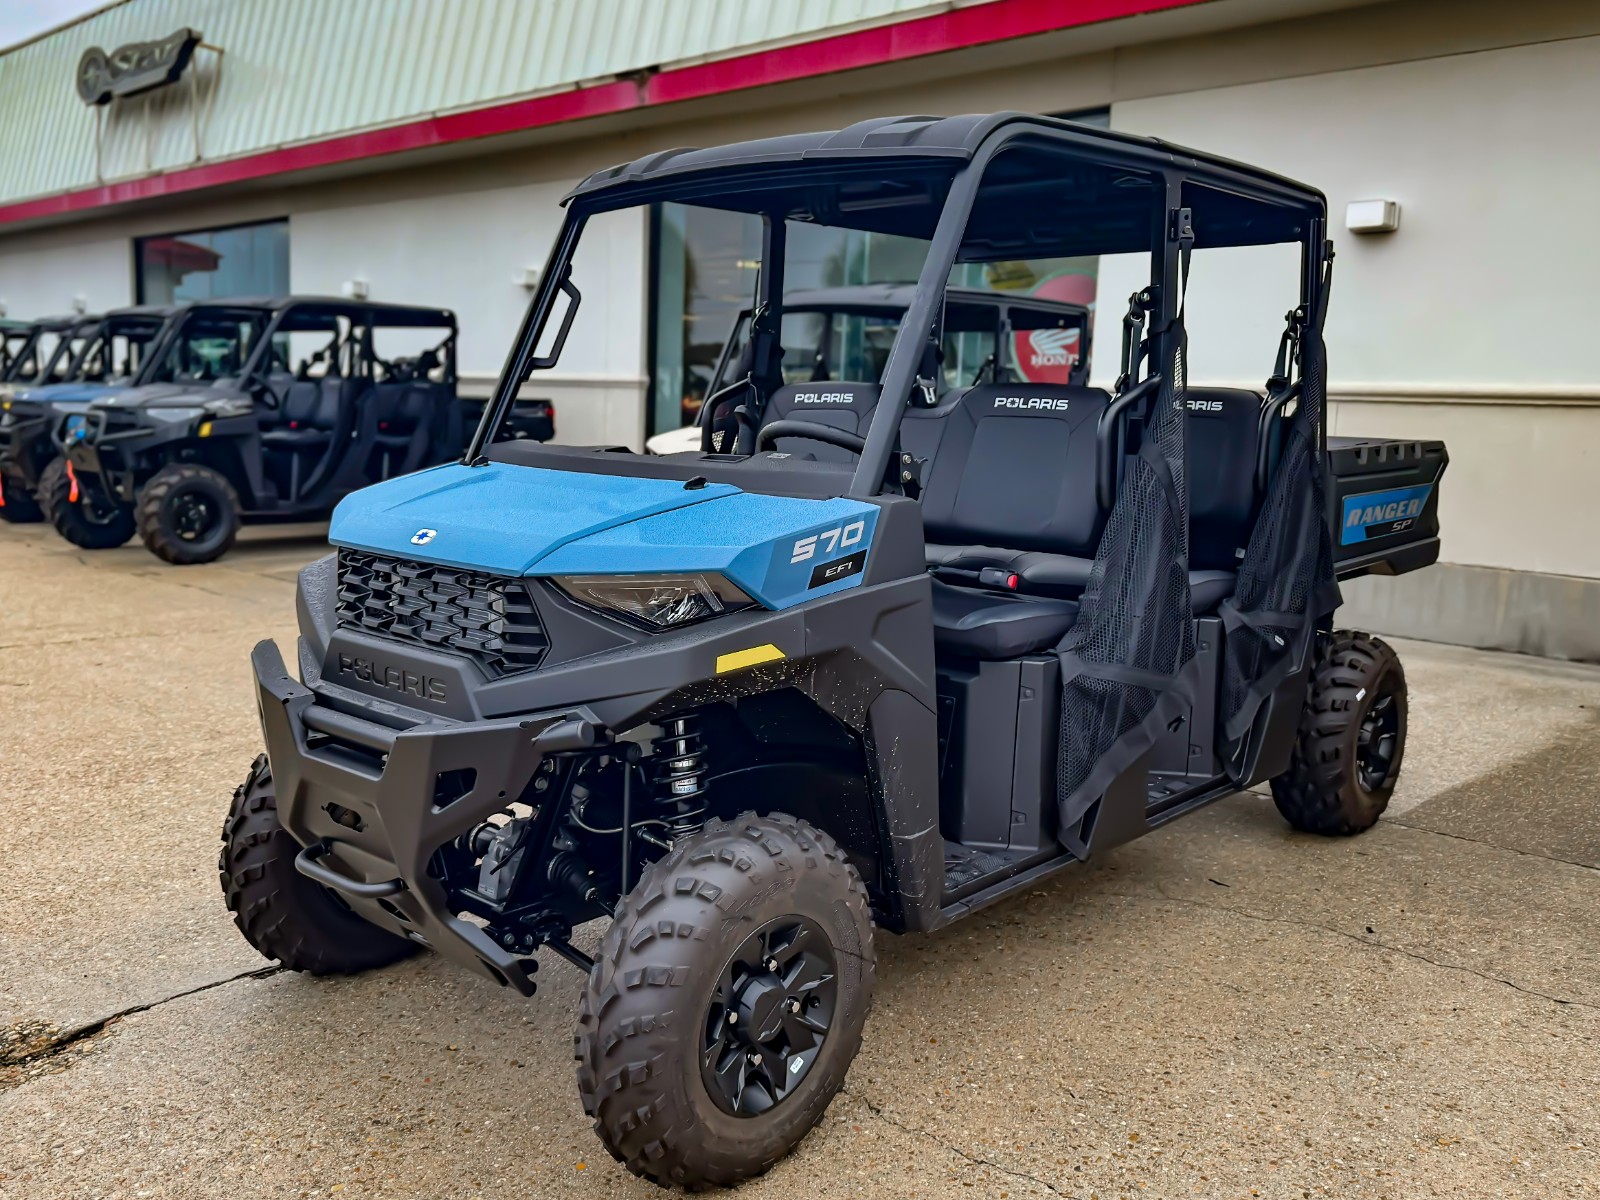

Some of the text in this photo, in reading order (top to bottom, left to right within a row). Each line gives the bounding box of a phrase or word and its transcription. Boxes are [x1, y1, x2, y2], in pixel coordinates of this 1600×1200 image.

[1030, 353, 1080, 368] HOND
[794, 393, 854, 403] POLARIS
[993, 397, 1069, 411] POLARIS
[1346, 499, 1419, 528] RANGER
[1391, 519, 1413, 532] SP
[824, 561, 853, 578] EFI
[338, 652, 447, 704] POLARIS
